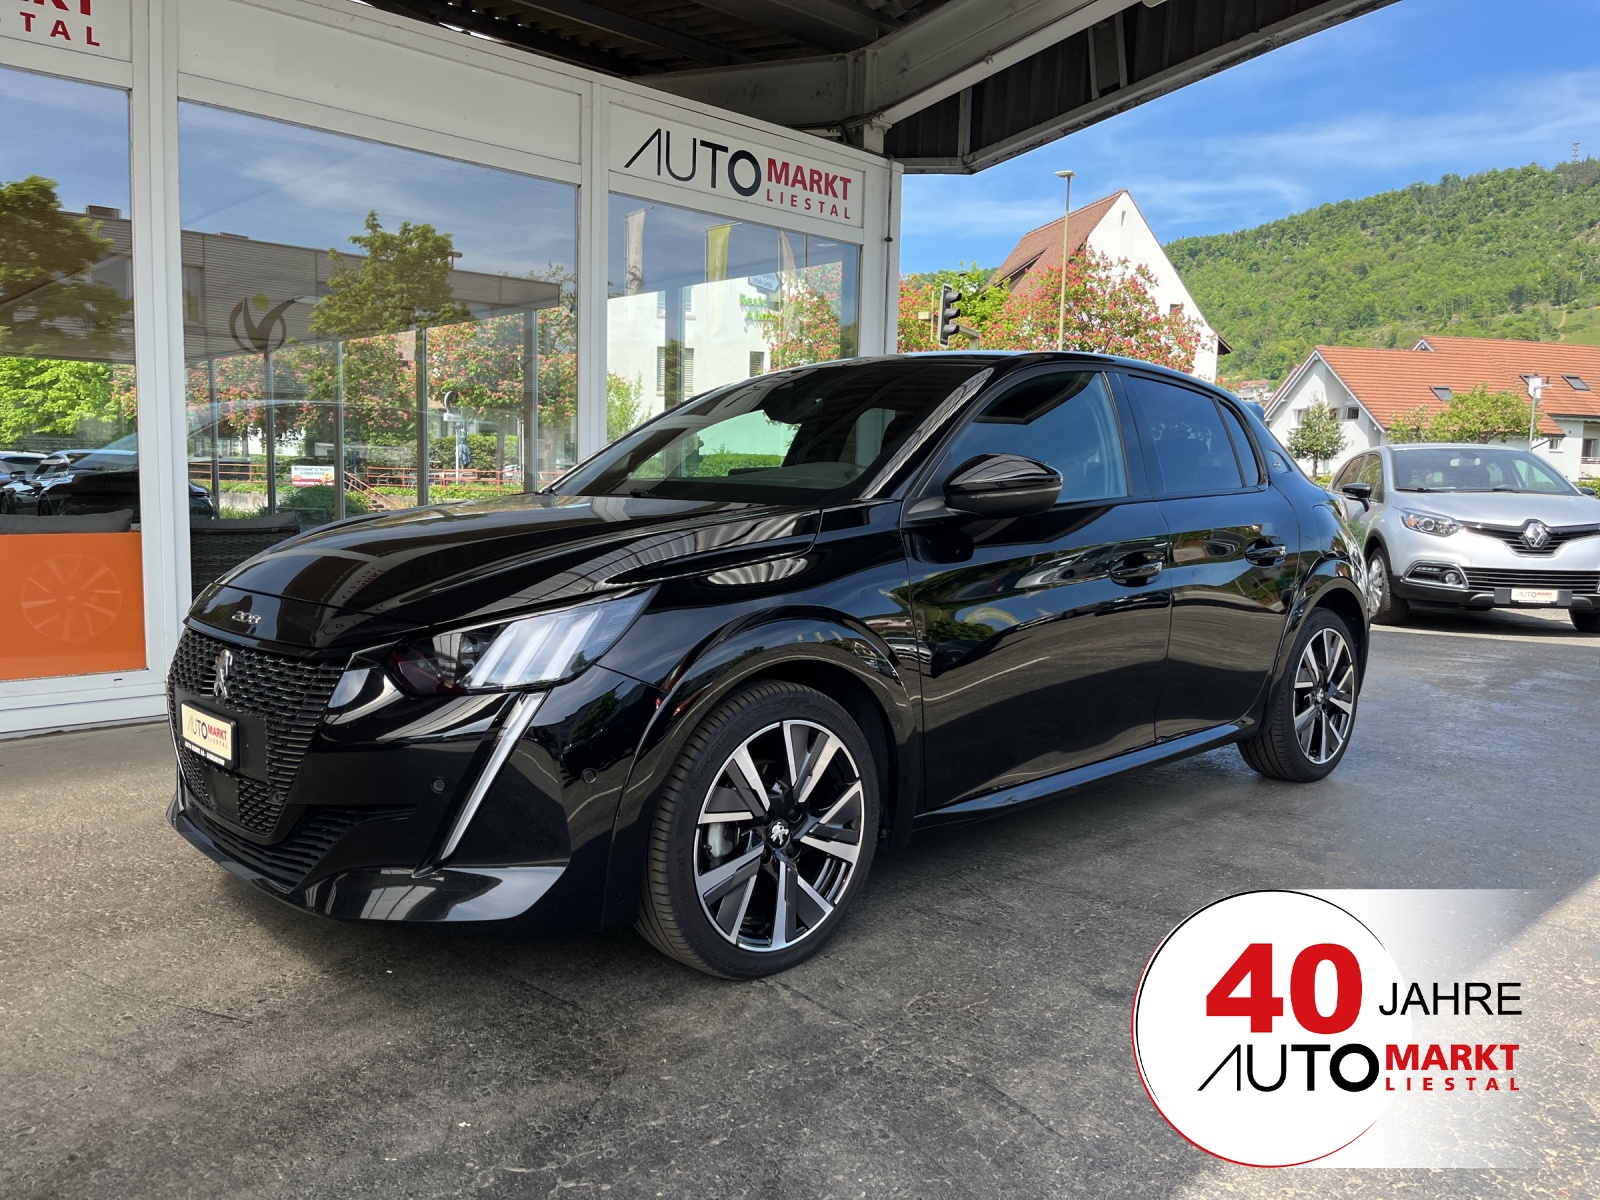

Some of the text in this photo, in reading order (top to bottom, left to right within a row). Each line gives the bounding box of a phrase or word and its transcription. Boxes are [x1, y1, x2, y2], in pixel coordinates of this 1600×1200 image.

[767, 157, 852, 201] MARKT
[766, 188, 851, 219] LIESTAL
[231, 610, 262, 625] 208
[207, 723, 227, 741] MARKT
[208, 736, 228, 749] LIESTAL
